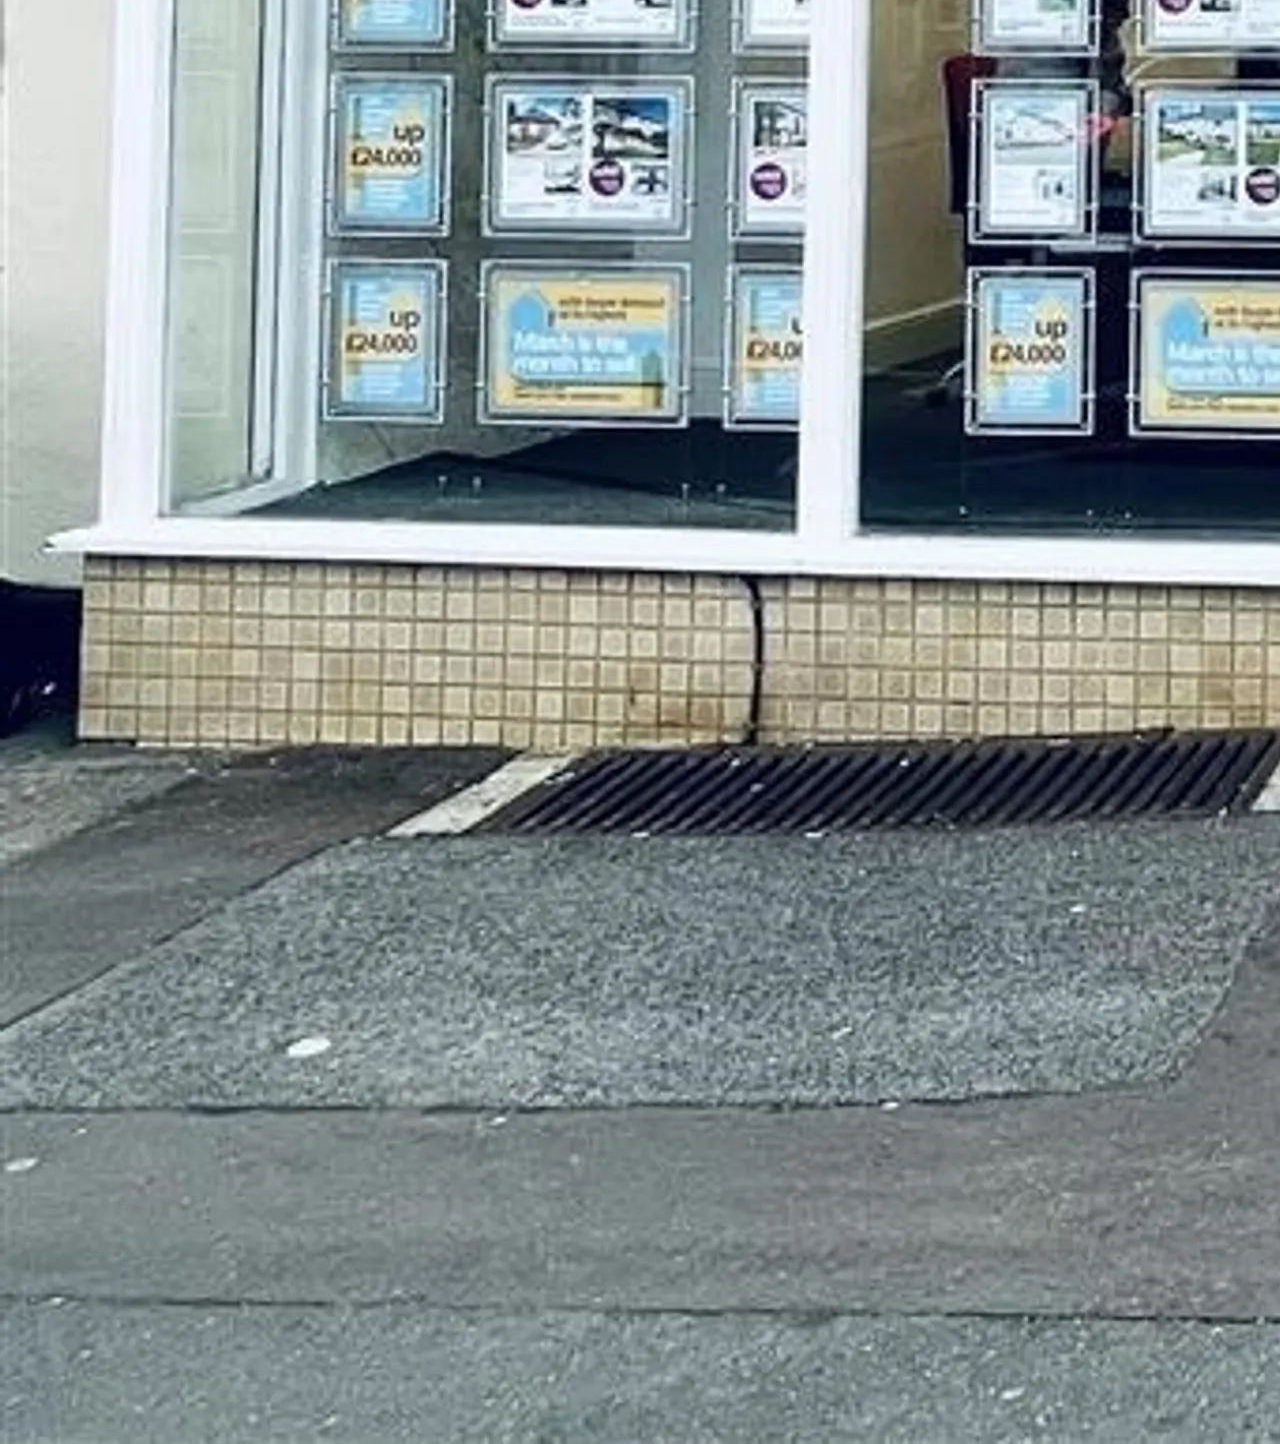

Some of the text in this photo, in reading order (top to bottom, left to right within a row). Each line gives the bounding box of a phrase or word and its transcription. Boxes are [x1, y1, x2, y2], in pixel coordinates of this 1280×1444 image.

[394, 125, 425, 146] up
[391, 310, 421, 330] up
[1035, 321, 1068, 342] up
[990, 345, 1065, 365] £24,000
